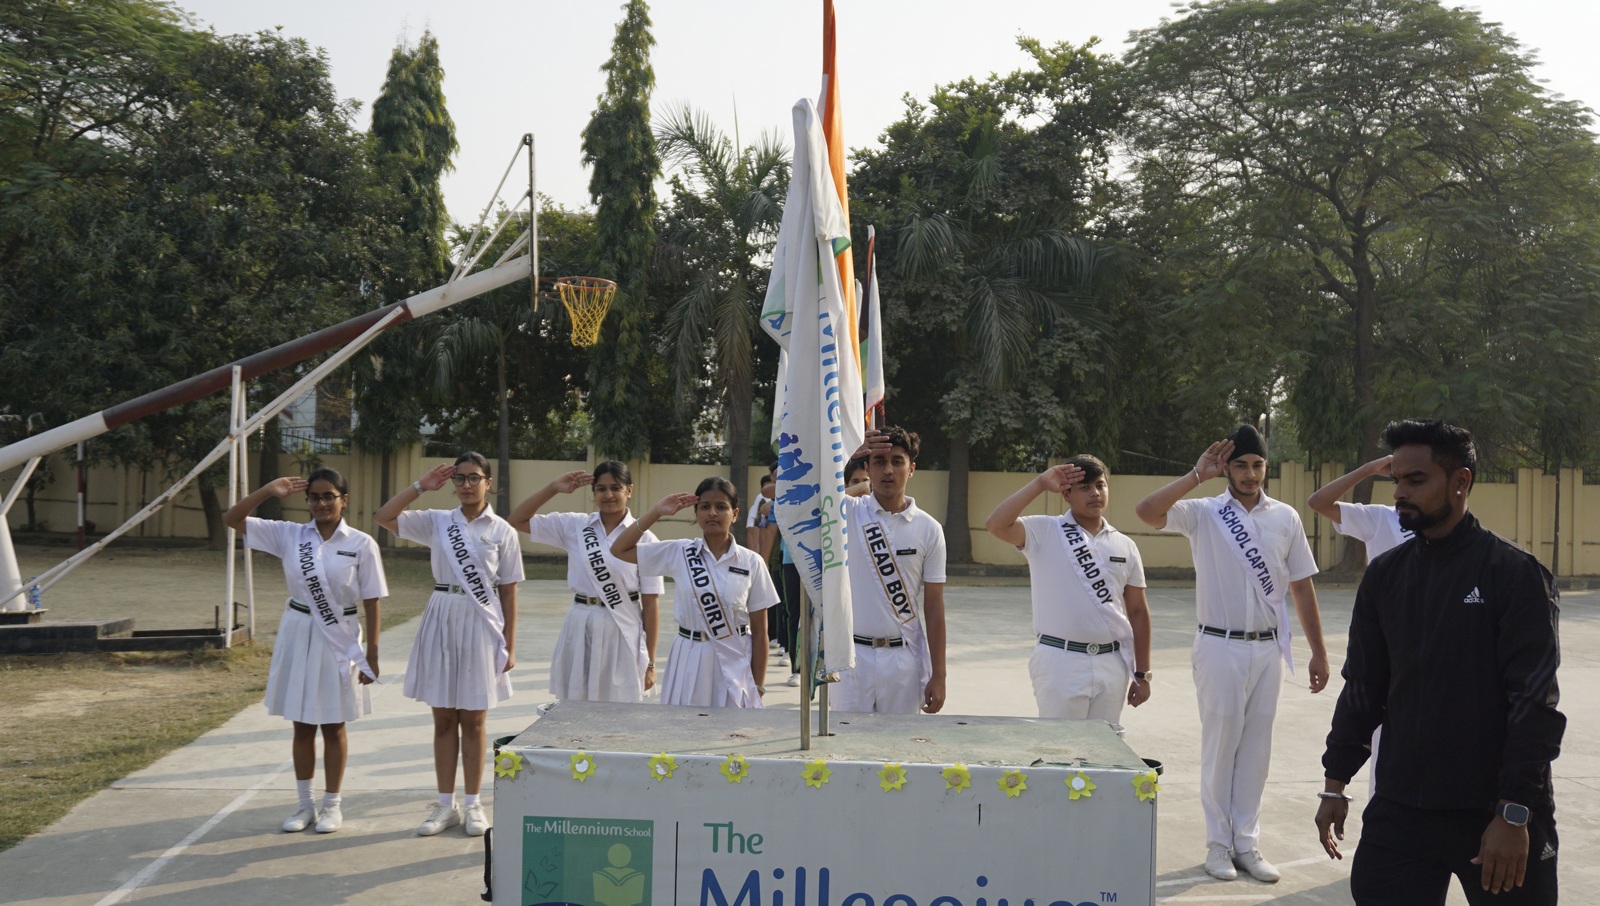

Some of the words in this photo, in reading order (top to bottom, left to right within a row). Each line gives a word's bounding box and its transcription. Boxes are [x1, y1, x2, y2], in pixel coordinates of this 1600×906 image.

[583, 527, 599, 550] VICE
[820, 495, 843, 574] School
[1218, 505, 1251, 549] SCHOOL
[1245, 547, 1275, 596] CAPTAIN
[299, 541, 315, 576] SCHOOL
[447, 524, 470, 565] SCHOOL
[462, 564, 491, 606] CAPTAIN
[588, 550, 611, 582] HEAD
[866, 526, 895, 576] HEAD
[886, 579, 911, 614] BOY
[1061, 522, 1084, 545] VICE
[1073, 544, 1100, 579] HEAD
[1091, 578, 1113, 604] BOY
[306, 575, 339, 626] PRESIDENT
[602, 583, 622, 609] GIRL
[686, 544, 710, 588] HEAD
[700, 592, 726, 636] GIRL
[525, 823, 542, 833] The
[543, 820, 623, 836] Millennium
[623, 827, 652, 838] School
[703, 821, 764, 854] The
[701, 866, 1101, 906] Milli
